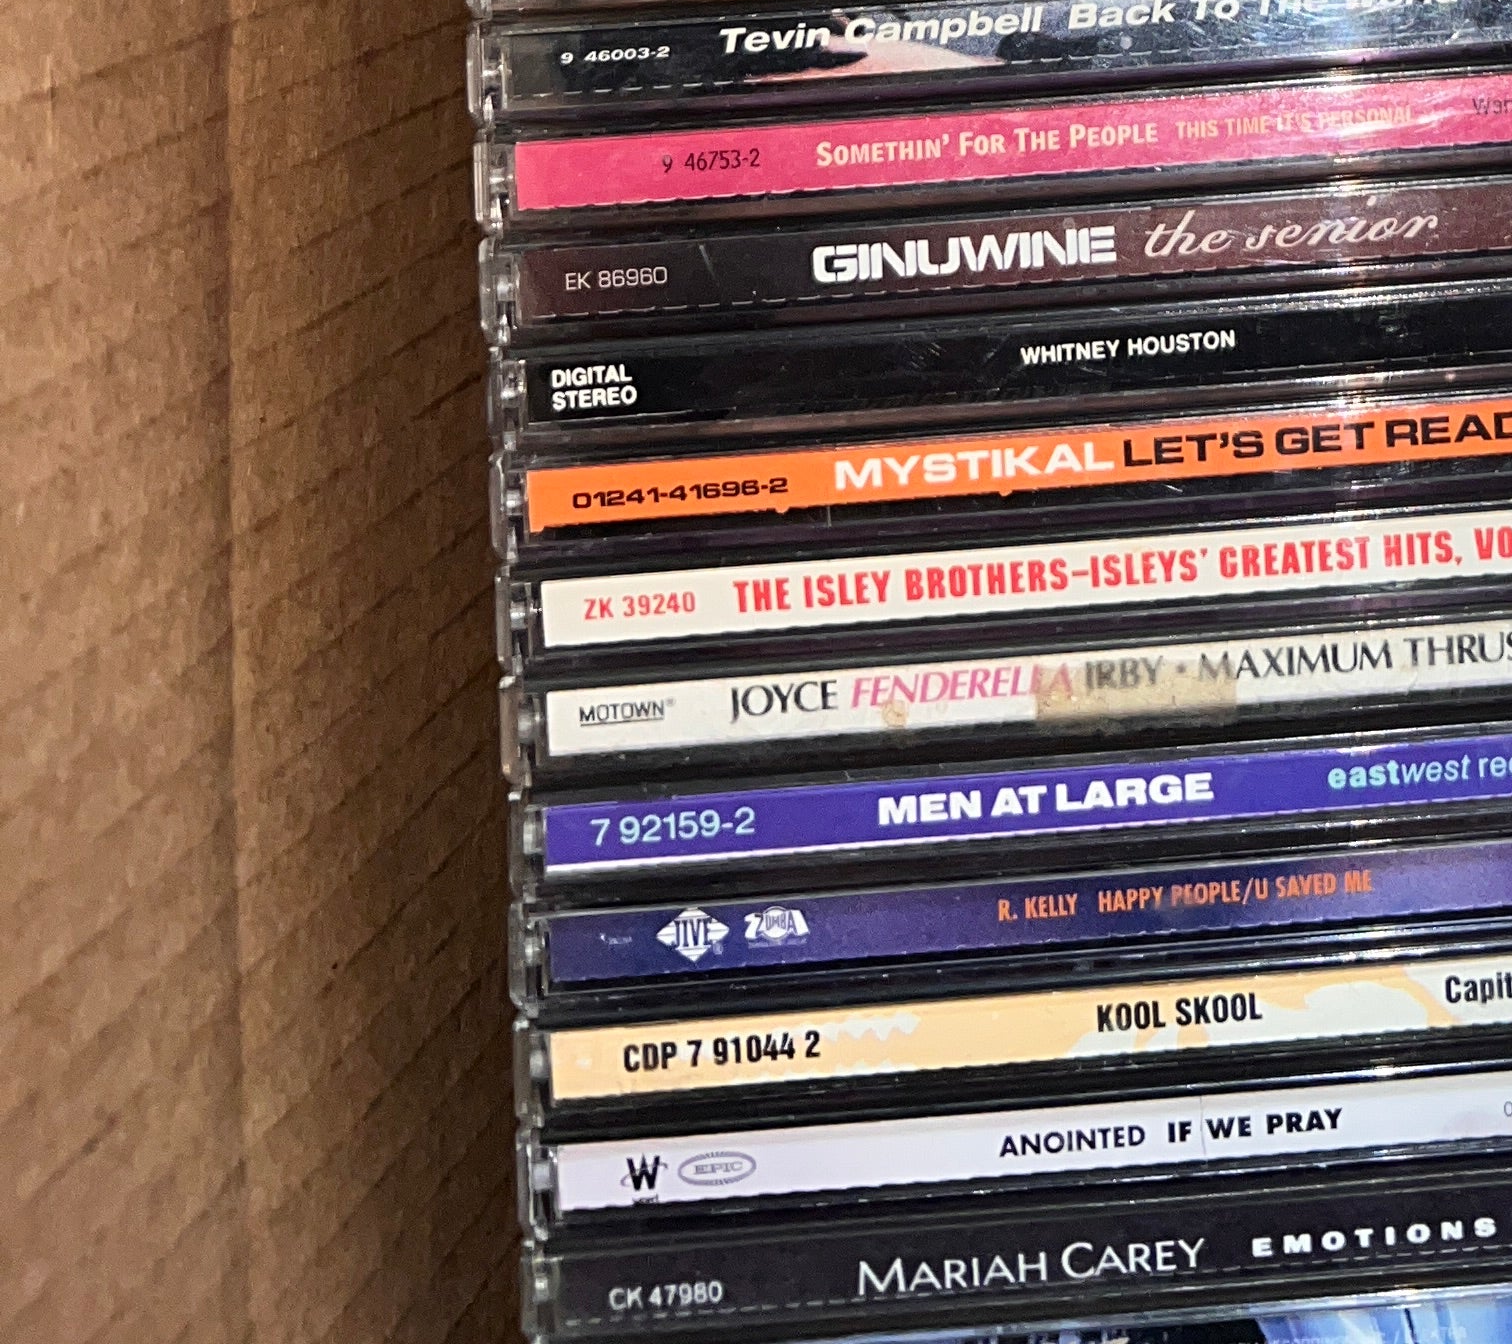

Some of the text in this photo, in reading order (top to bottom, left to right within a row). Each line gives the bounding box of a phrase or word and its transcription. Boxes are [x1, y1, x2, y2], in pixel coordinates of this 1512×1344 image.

[585, 4, 1042, 64] 46003-2 Tevin Campbell
[685, 118, 1270, 172] 46753-2 THIS TIME
[565, 272, 591, 291] EK
[598, 266, 668, 288] 86960
[551, 364, 632, 387] DIGITAL
[1021, 340, 1121, 366] WHITNEY
[1128, 330, 1236, 357] HOUSTON
[552, 386, 637, 411] STEREO
[835, 441, 1115, 491] MYSTIKAL
[1275, 422, 1374, 455] GET
[623, 536, 1370, 618] 39240 THE ISLEY GREATEST
[730, 680, 839, 724] JOYCE
[1200, 640, 1391, 682] MAXIMUM
[620, 807, 755, 842] 92159-2
[878, 790, 981, 826] MEN
[991, 785, 1047, 817] AT
[1055, 771, 1214, 812] LARGE
[1025, 893, 1077, 918] KELLY
[1099, 888, 1163, 913] HAPPY
[624, 1042, 676, 1073] CDP
[713, 1034, 796, 1066] 91044
[1097, 1000, 1165, 1032] KOOL
[1175, 993, 1262, 1027] SKOOL
[1000, 1109, 1342, 1157] ANOINTED IF WE PRAY
[648, 1281, 723, 1306] 47980
[1252, 1217, 1497, 1257] EMOTIONS
